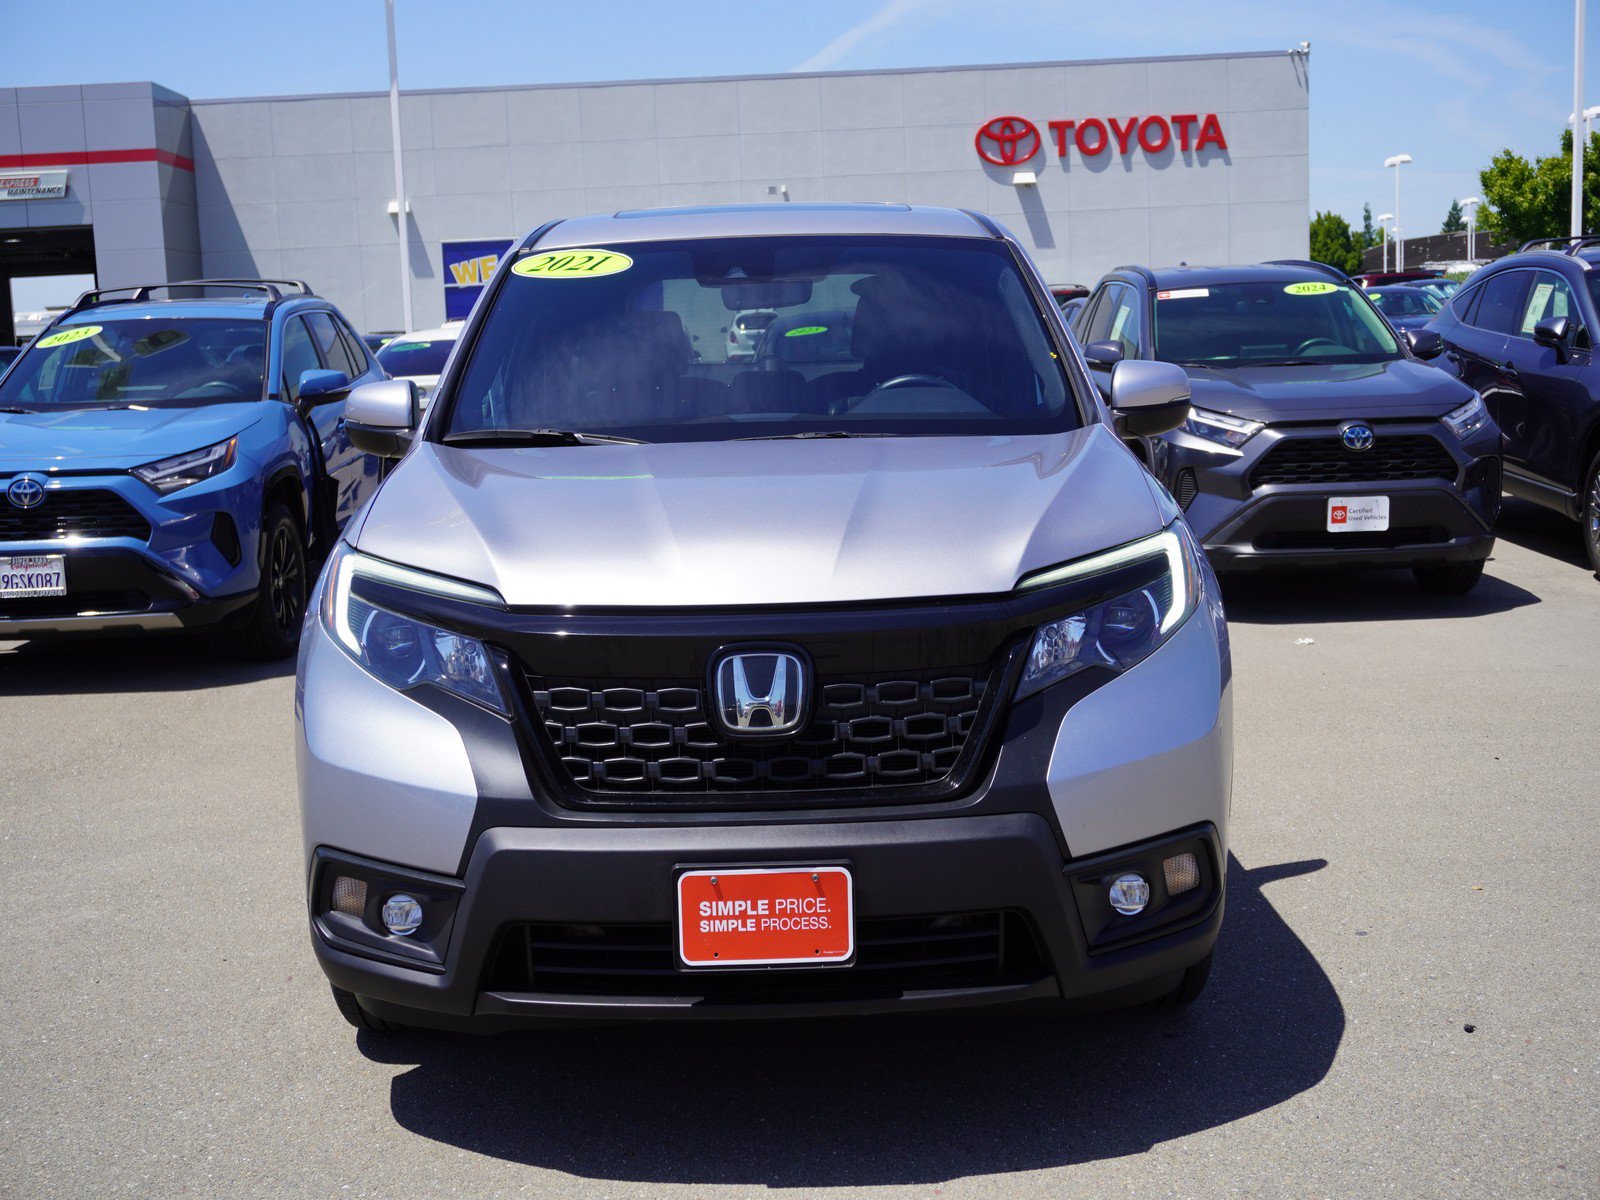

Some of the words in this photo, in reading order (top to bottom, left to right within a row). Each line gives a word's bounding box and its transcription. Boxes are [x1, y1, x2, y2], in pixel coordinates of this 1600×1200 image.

[1048, 113, 1228, 157] TOYOTA
[7, 185, 63, 196] MAINTENANCE
[526, 255, 612, 272] 2021
[1296, 284, 1326, 293] 2024
[2, 572, 60, 589] 9GSK087
[699, 900, 769, 916] SIMPLE
[775, 898, 831, 914] PRICE.
[699, 919, 756, 933] SIMPLE
[761, 917, 832, 931] PROCESS.
